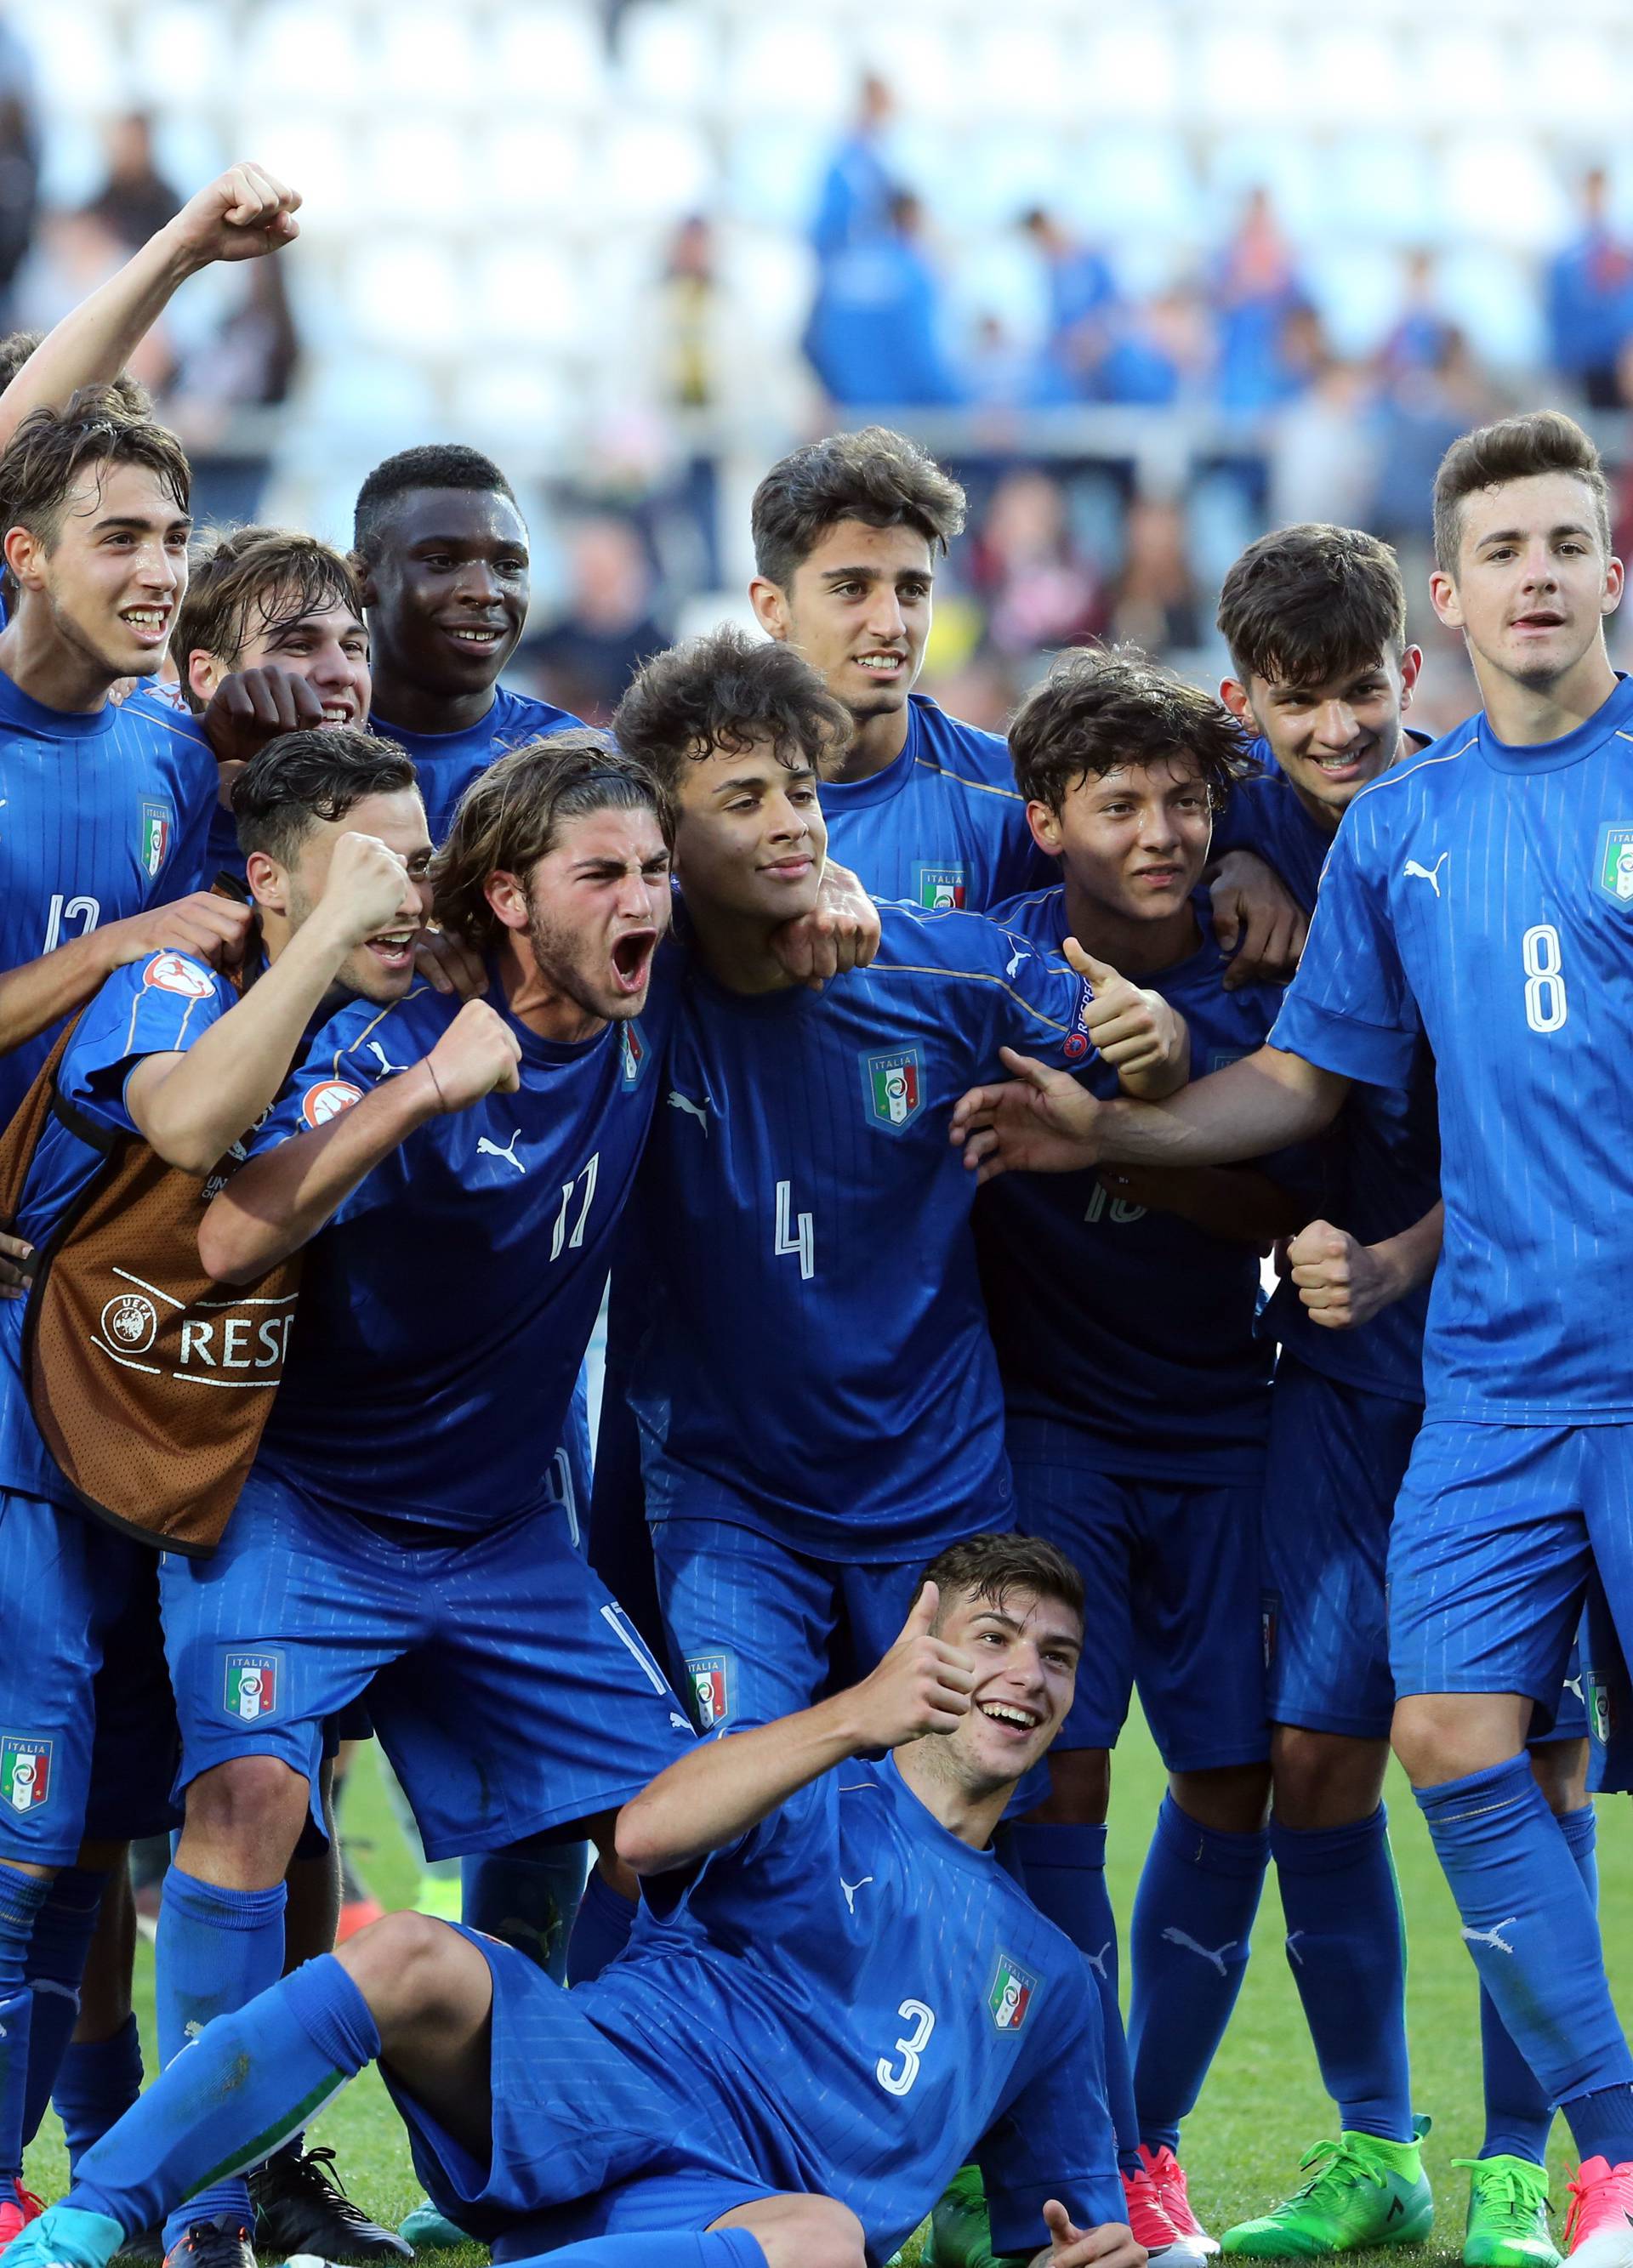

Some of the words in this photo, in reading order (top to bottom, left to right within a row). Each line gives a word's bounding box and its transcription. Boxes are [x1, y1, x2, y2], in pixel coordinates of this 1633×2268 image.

[146, 808, 166, 819] ITALIA
[927, 875, 962, 884] ITALIA
[1522, 924, 1568, 1033] 8
[874, 1056, 912, 1070] ITALIA
[549, 1151, 600, 1262] 17
[775, 1179, 815, 1281] 4
[122, 1298, 152, 1321] UEFA
[232, 1658, 270, 1668] ITALIA
[688, 1662, 720, 1673] ITALIA
[8, 1742, 46, 1754] ITALIA
[1004, 1961, 1030, 1987] ITALIA
[876, 1998, 936, 2096] 3
